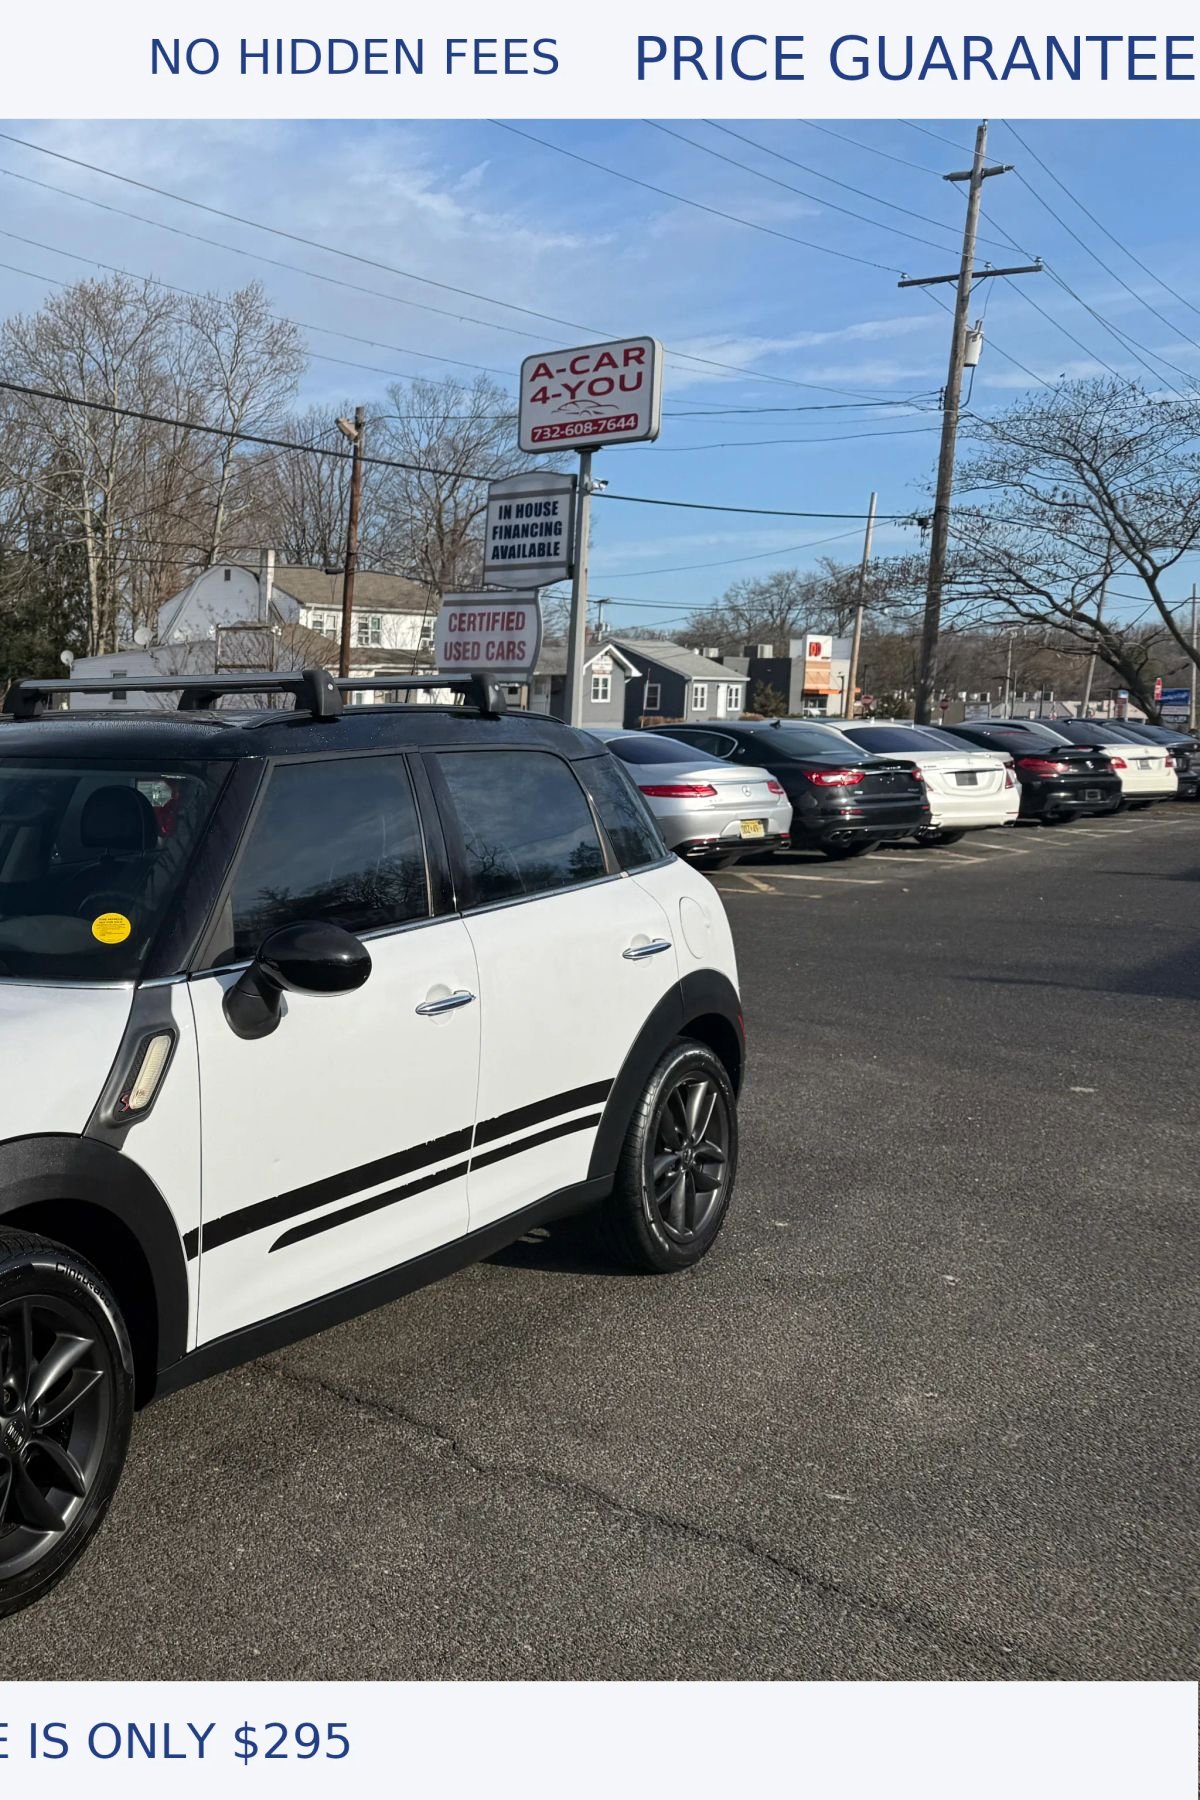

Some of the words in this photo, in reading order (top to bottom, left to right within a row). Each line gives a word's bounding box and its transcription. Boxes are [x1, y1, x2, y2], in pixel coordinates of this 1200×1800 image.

[529, 346, 646, 382] A-CAR
[530, 371, 643, 405] 4-YOU
[533, 414, 637, 441] 732-608-7644
[499, 504, 511, 520] IN
[515, 500, 559, 519] HOUSE
[492, 520, 563, 541] FINANCING
[491, 540, 561, 561] AVAILABLE
[449, 611, 526, 633] CERTIFIED
[443, 642, 481, 662] USED
[485, 640, 526, 661] CARS
